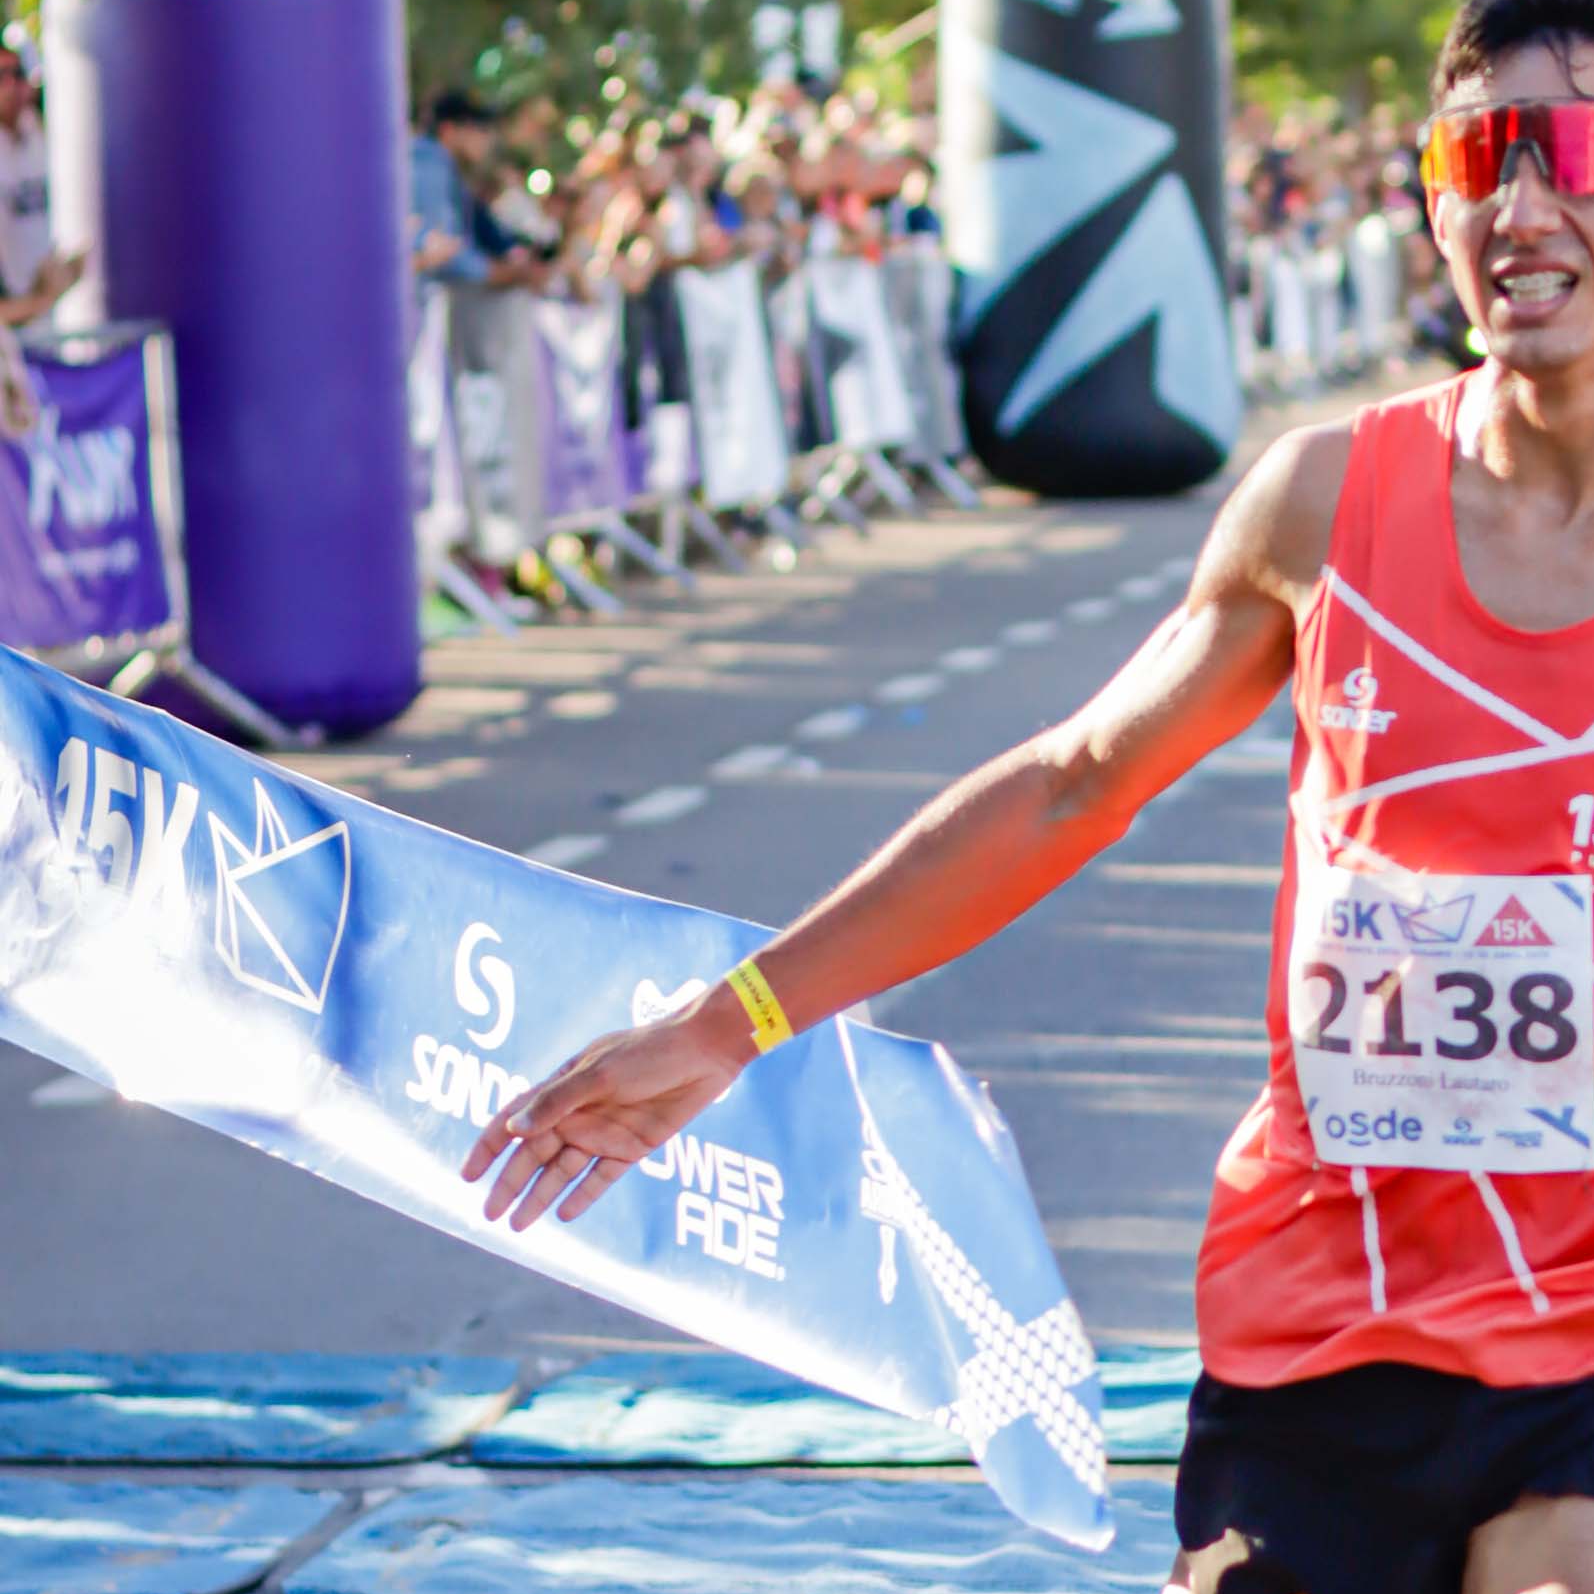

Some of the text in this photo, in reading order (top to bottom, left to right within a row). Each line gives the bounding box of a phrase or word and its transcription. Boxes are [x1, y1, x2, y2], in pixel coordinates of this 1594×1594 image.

[1491, 917, 1536, 941] 15K
[1303, 962, 1578, 1063] 2138
[1325, 1108, 1423, 1145] osde
